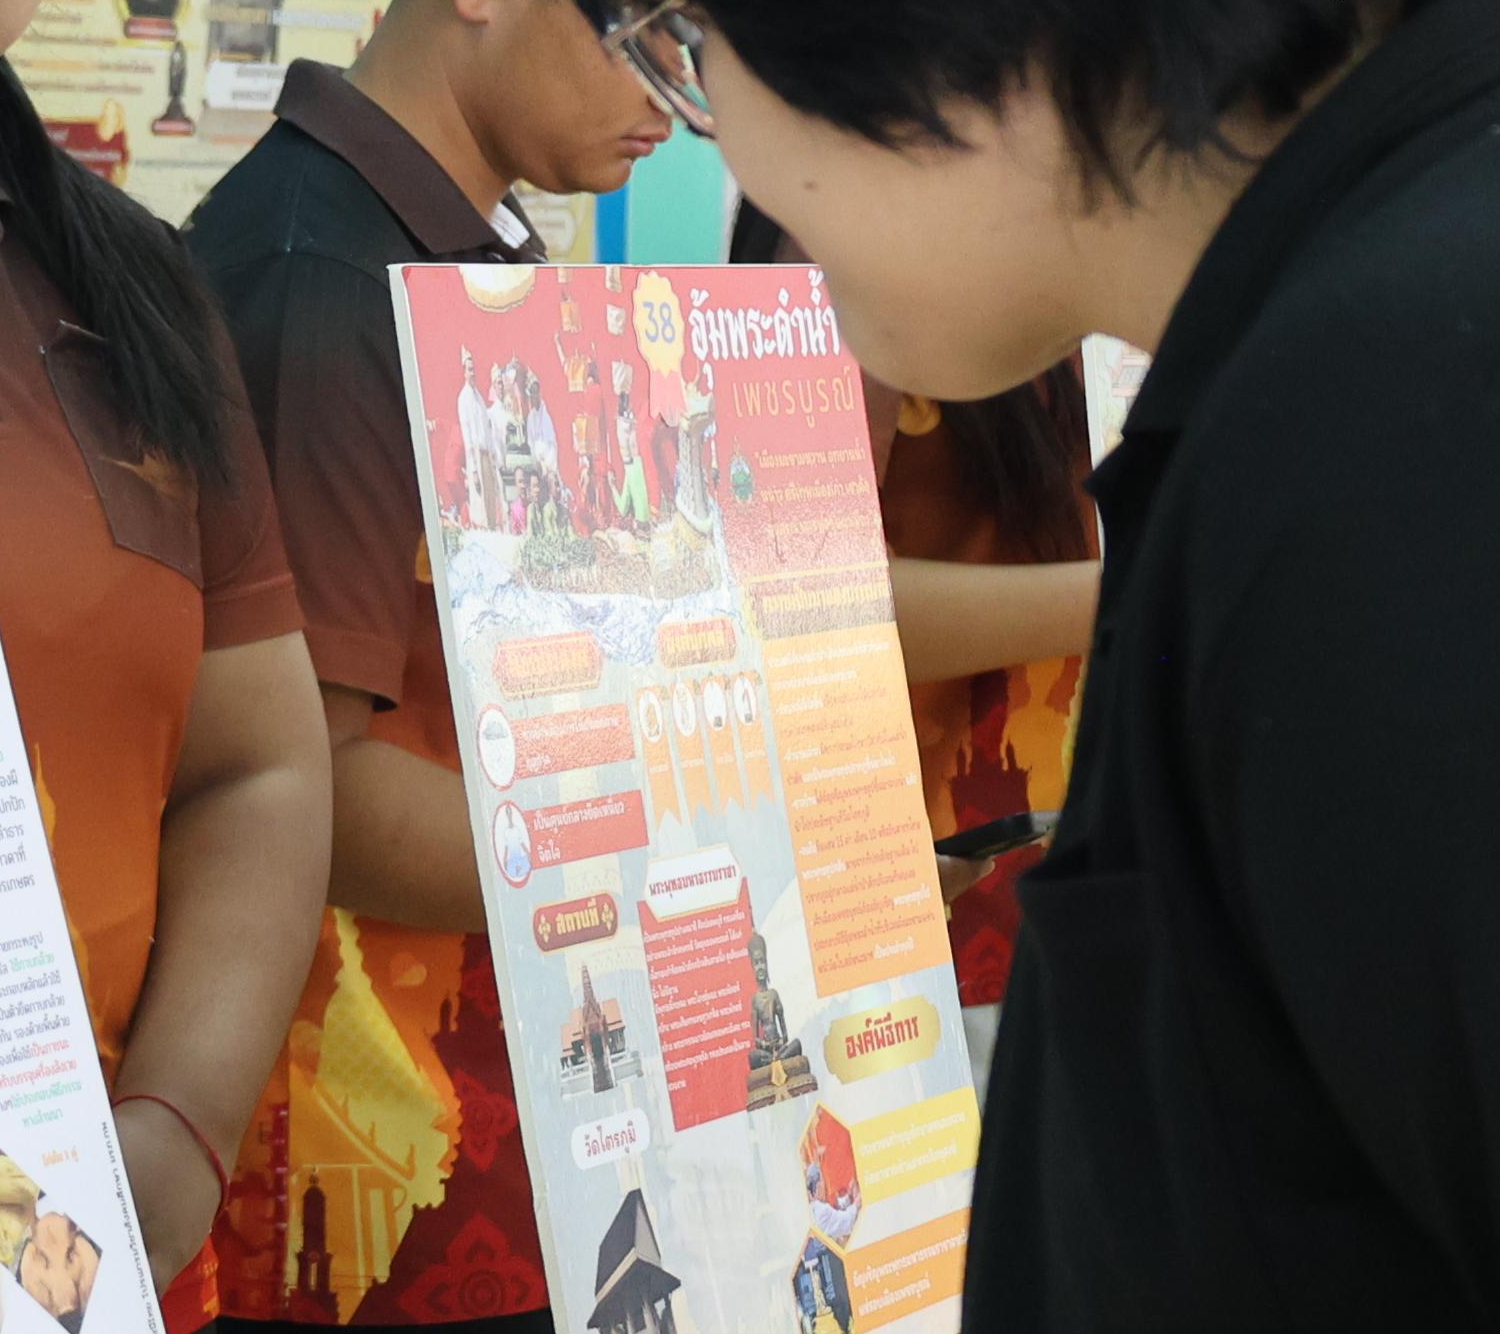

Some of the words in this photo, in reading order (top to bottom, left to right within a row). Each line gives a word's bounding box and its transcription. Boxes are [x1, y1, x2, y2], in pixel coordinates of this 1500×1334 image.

[642, 301, 677, 345] 38
[688, 269, 841, 390] อุ้มพระดำน้ำ
[732, 364, 855, 429] เพชรบูรณ์
